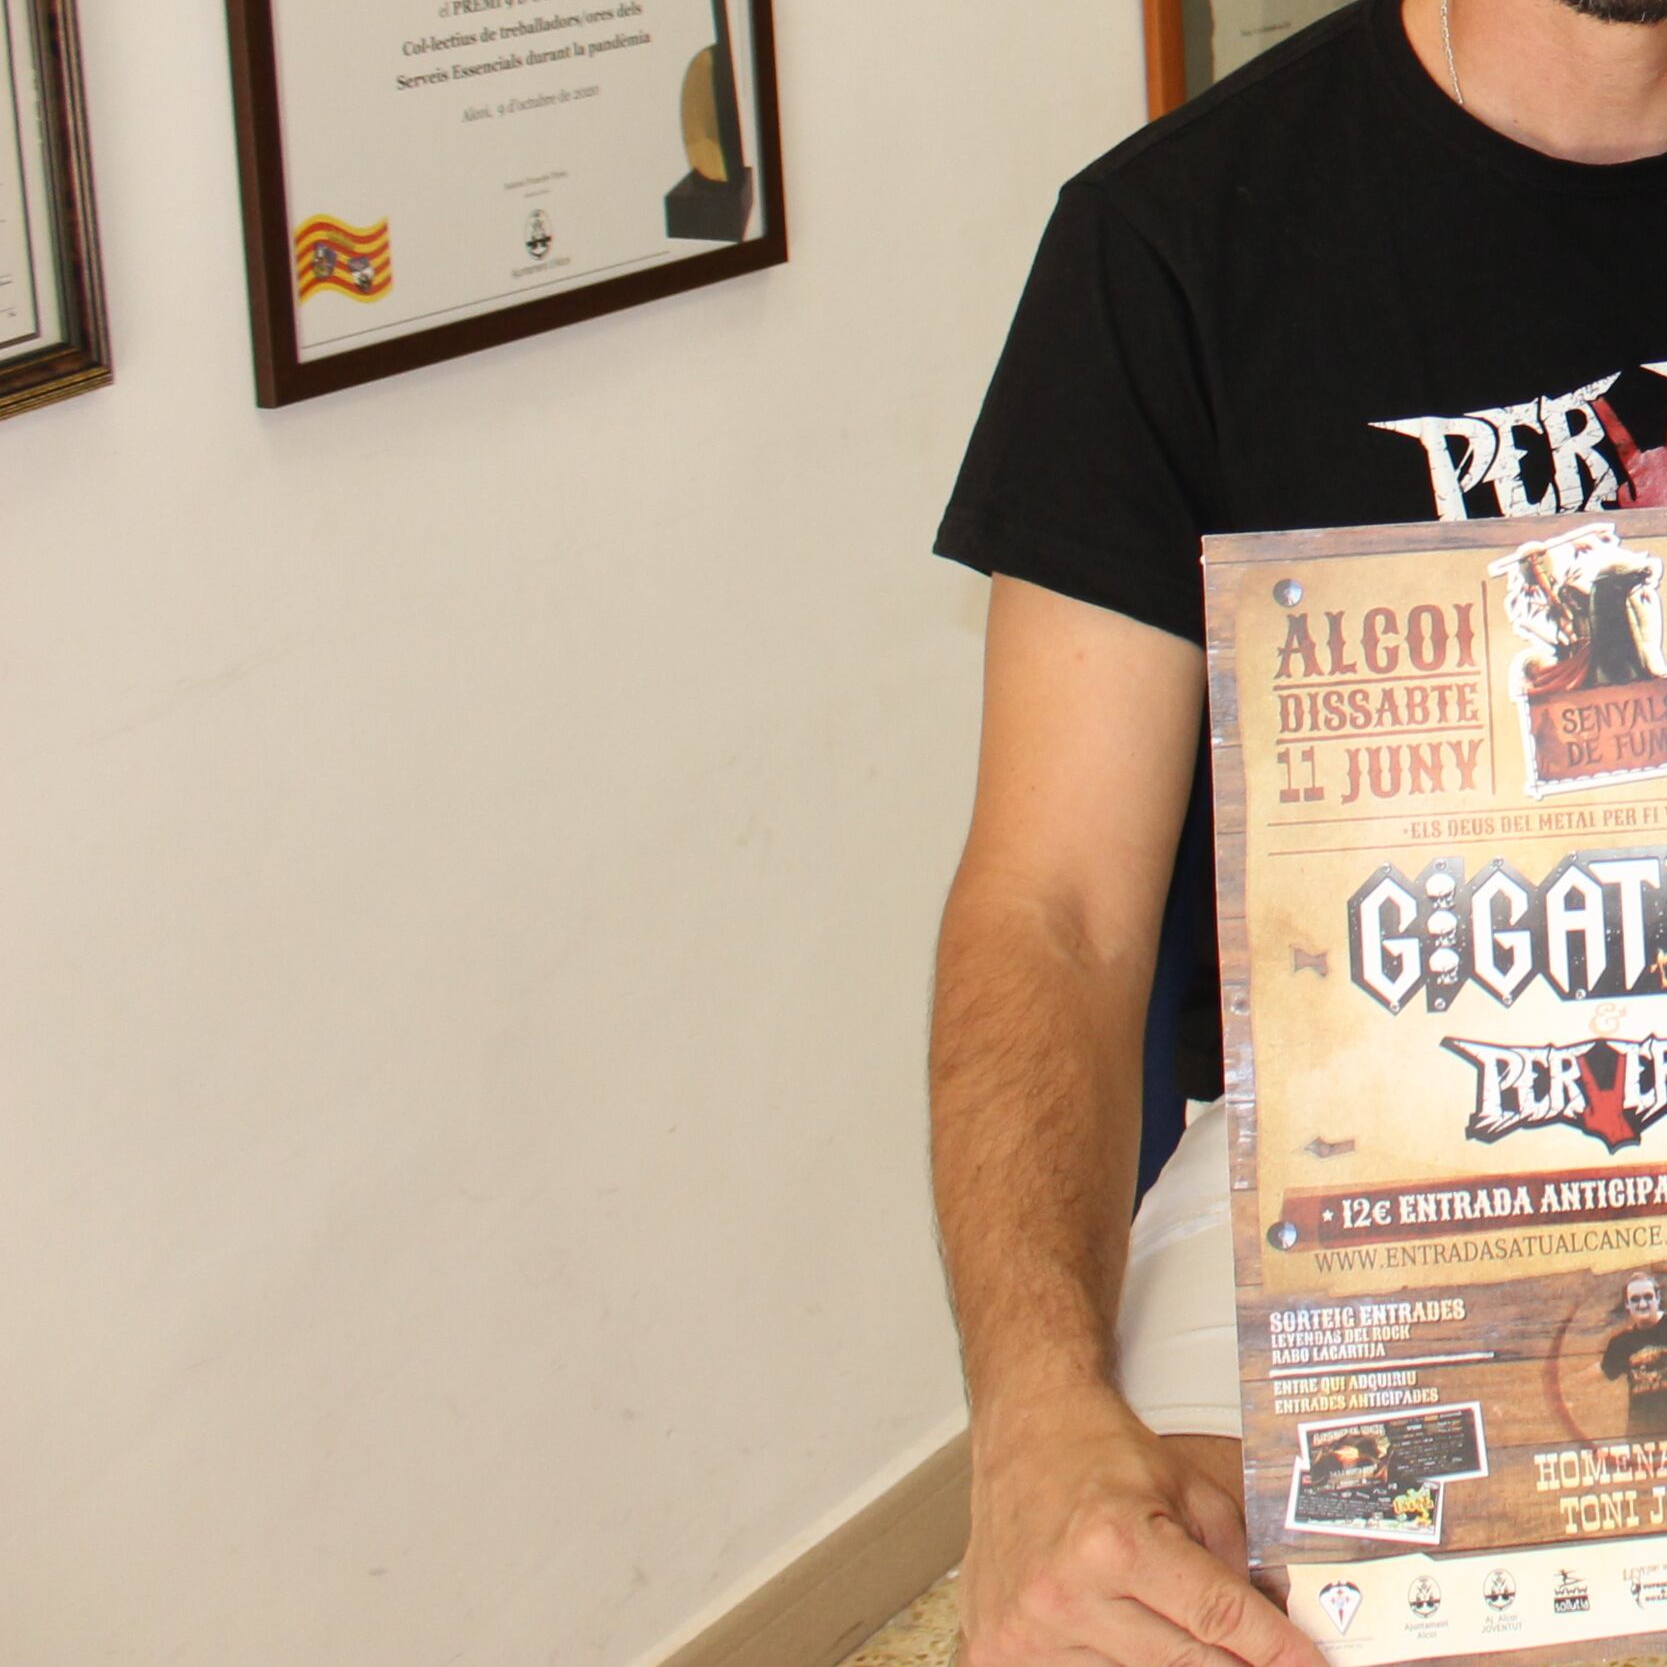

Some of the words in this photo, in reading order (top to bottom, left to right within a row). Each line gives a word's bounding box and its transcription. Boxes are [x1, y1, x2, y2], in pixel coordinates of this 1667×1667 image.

[480, 26, 498, 44] de
[616, 0, 644, 19] dels
[397, 68, 449, 91] Serveis
[452, 55, 524, 80] Essencials
[526, 45, 573, 67] durant
[573, 42, 586, 57] la
[1273, 603, 1476, 680] ALCOI
[1278, 683, 1479, 734] DISSABTE
[1277, 745, 1325, 804] 11
[1341, 738, 1485, 805] JUNY
[1566, 739, 1604, 768] DE
[1447, 816, 1496, 838] DEUS
[1500, 813, 1534, 835] DEL
[1538, 809, 1598, 832] METAL
[1602, 806, 1637, 827] PER
[1642, 805, 1661, 824] FI
[1342, 1196, 1392, 1229] 12€
[1399, 1184, 1534, 1224] ENTRADA
[1269, 1306, 1355, 1333] SORTEIG
[1359, 1298, 1467, 1327] ENTRADES
[1271, 1327, 1342, 1349] LEYENDAS
[1344, 1326, 1369, 1343] DEL
[1372, 1324, 1411, 1342] ROCK
[1272, 1346, 1309, 1365] RABO
[1313, 1342, 1386, 1362] LAGARTIJA
[1274, 1378, 1318, 1396] ENTRE
[1320, 1375, 1346, 1395] QUI
[1349, 1370, 1417, 1392] ADQUIRIU
[1275, 1394, 1346, 1415] ENTRADES
[1349, 1387, 1439, 1410] ANTICIPADES
[1560, 1490, 1640, 1534] TONI
